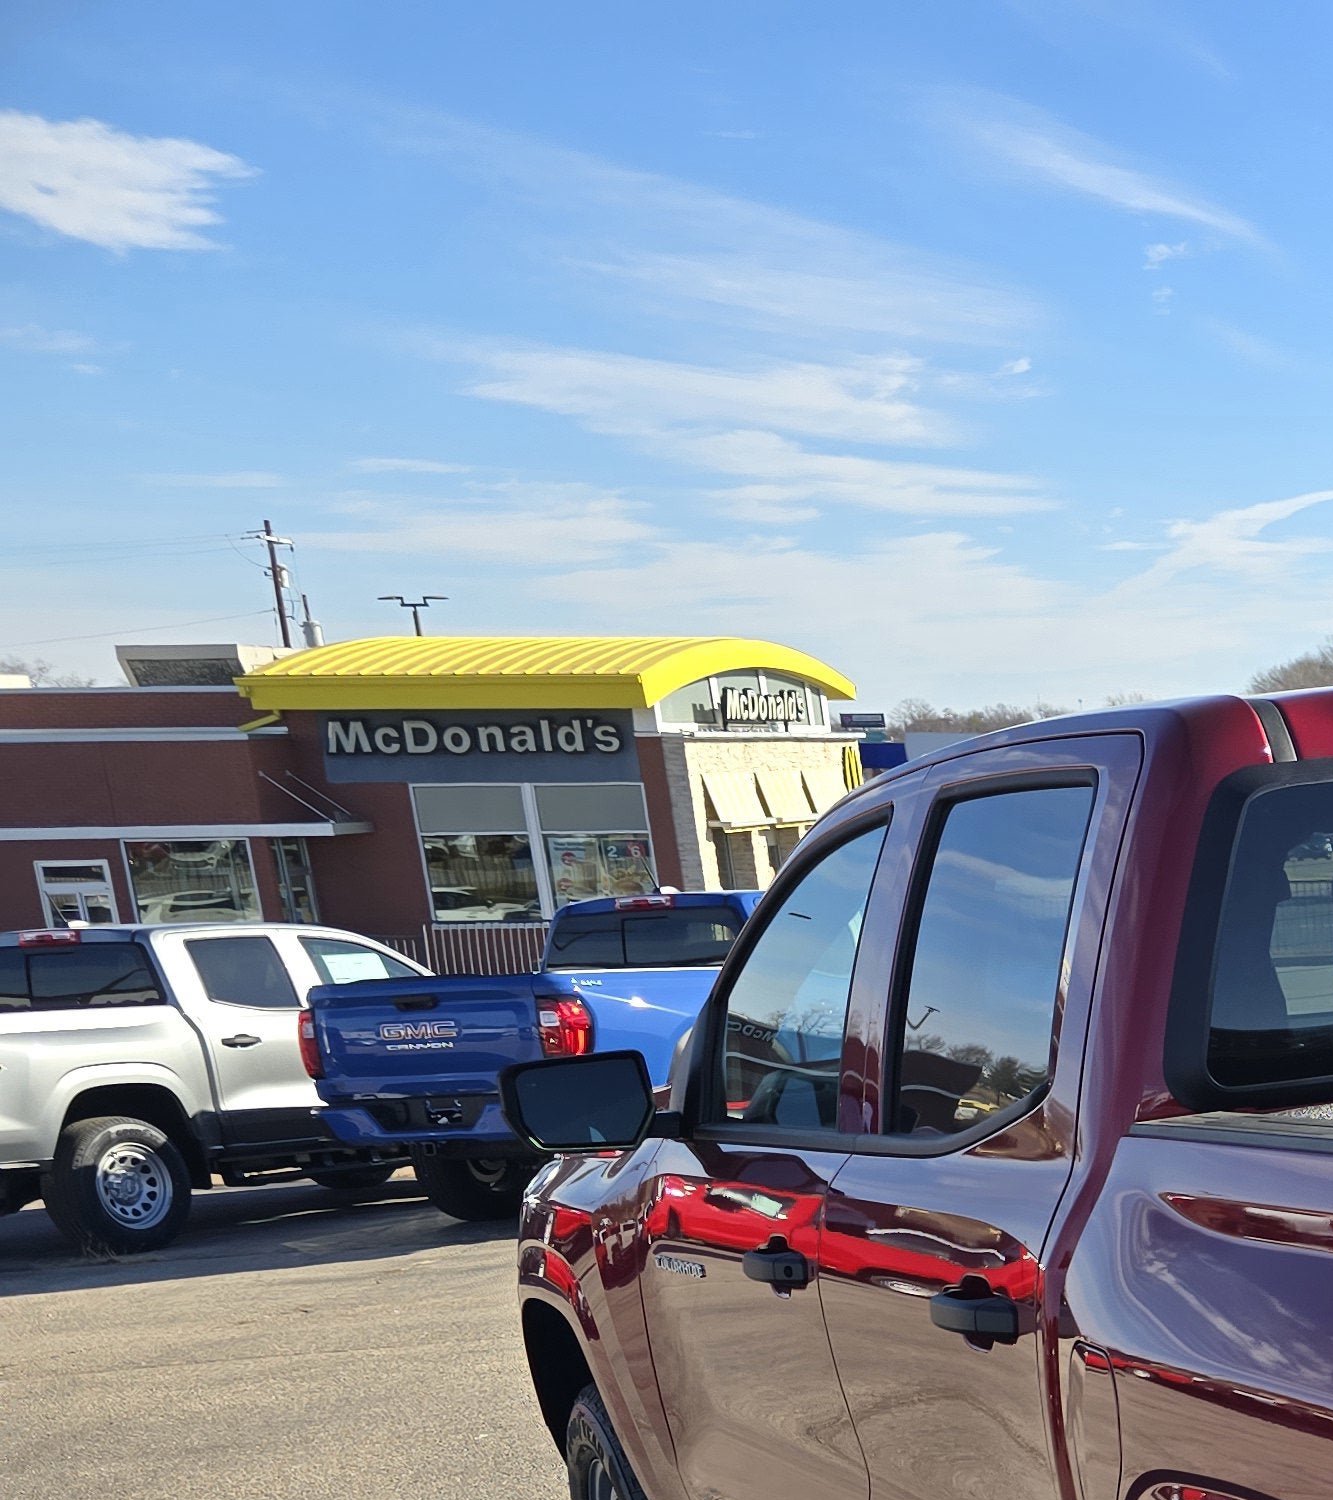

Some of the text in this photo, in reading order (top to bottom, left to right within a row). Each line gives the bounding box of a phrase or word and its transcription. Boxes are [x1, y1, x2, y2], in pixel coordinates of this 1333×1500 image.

[726, 688, 805, 722] McDonald's
[327, 718, 622, 755] McDonald's
[379, 1021, 459, 1041] GMC
[386, 1041, 454, 1051] CANYON
